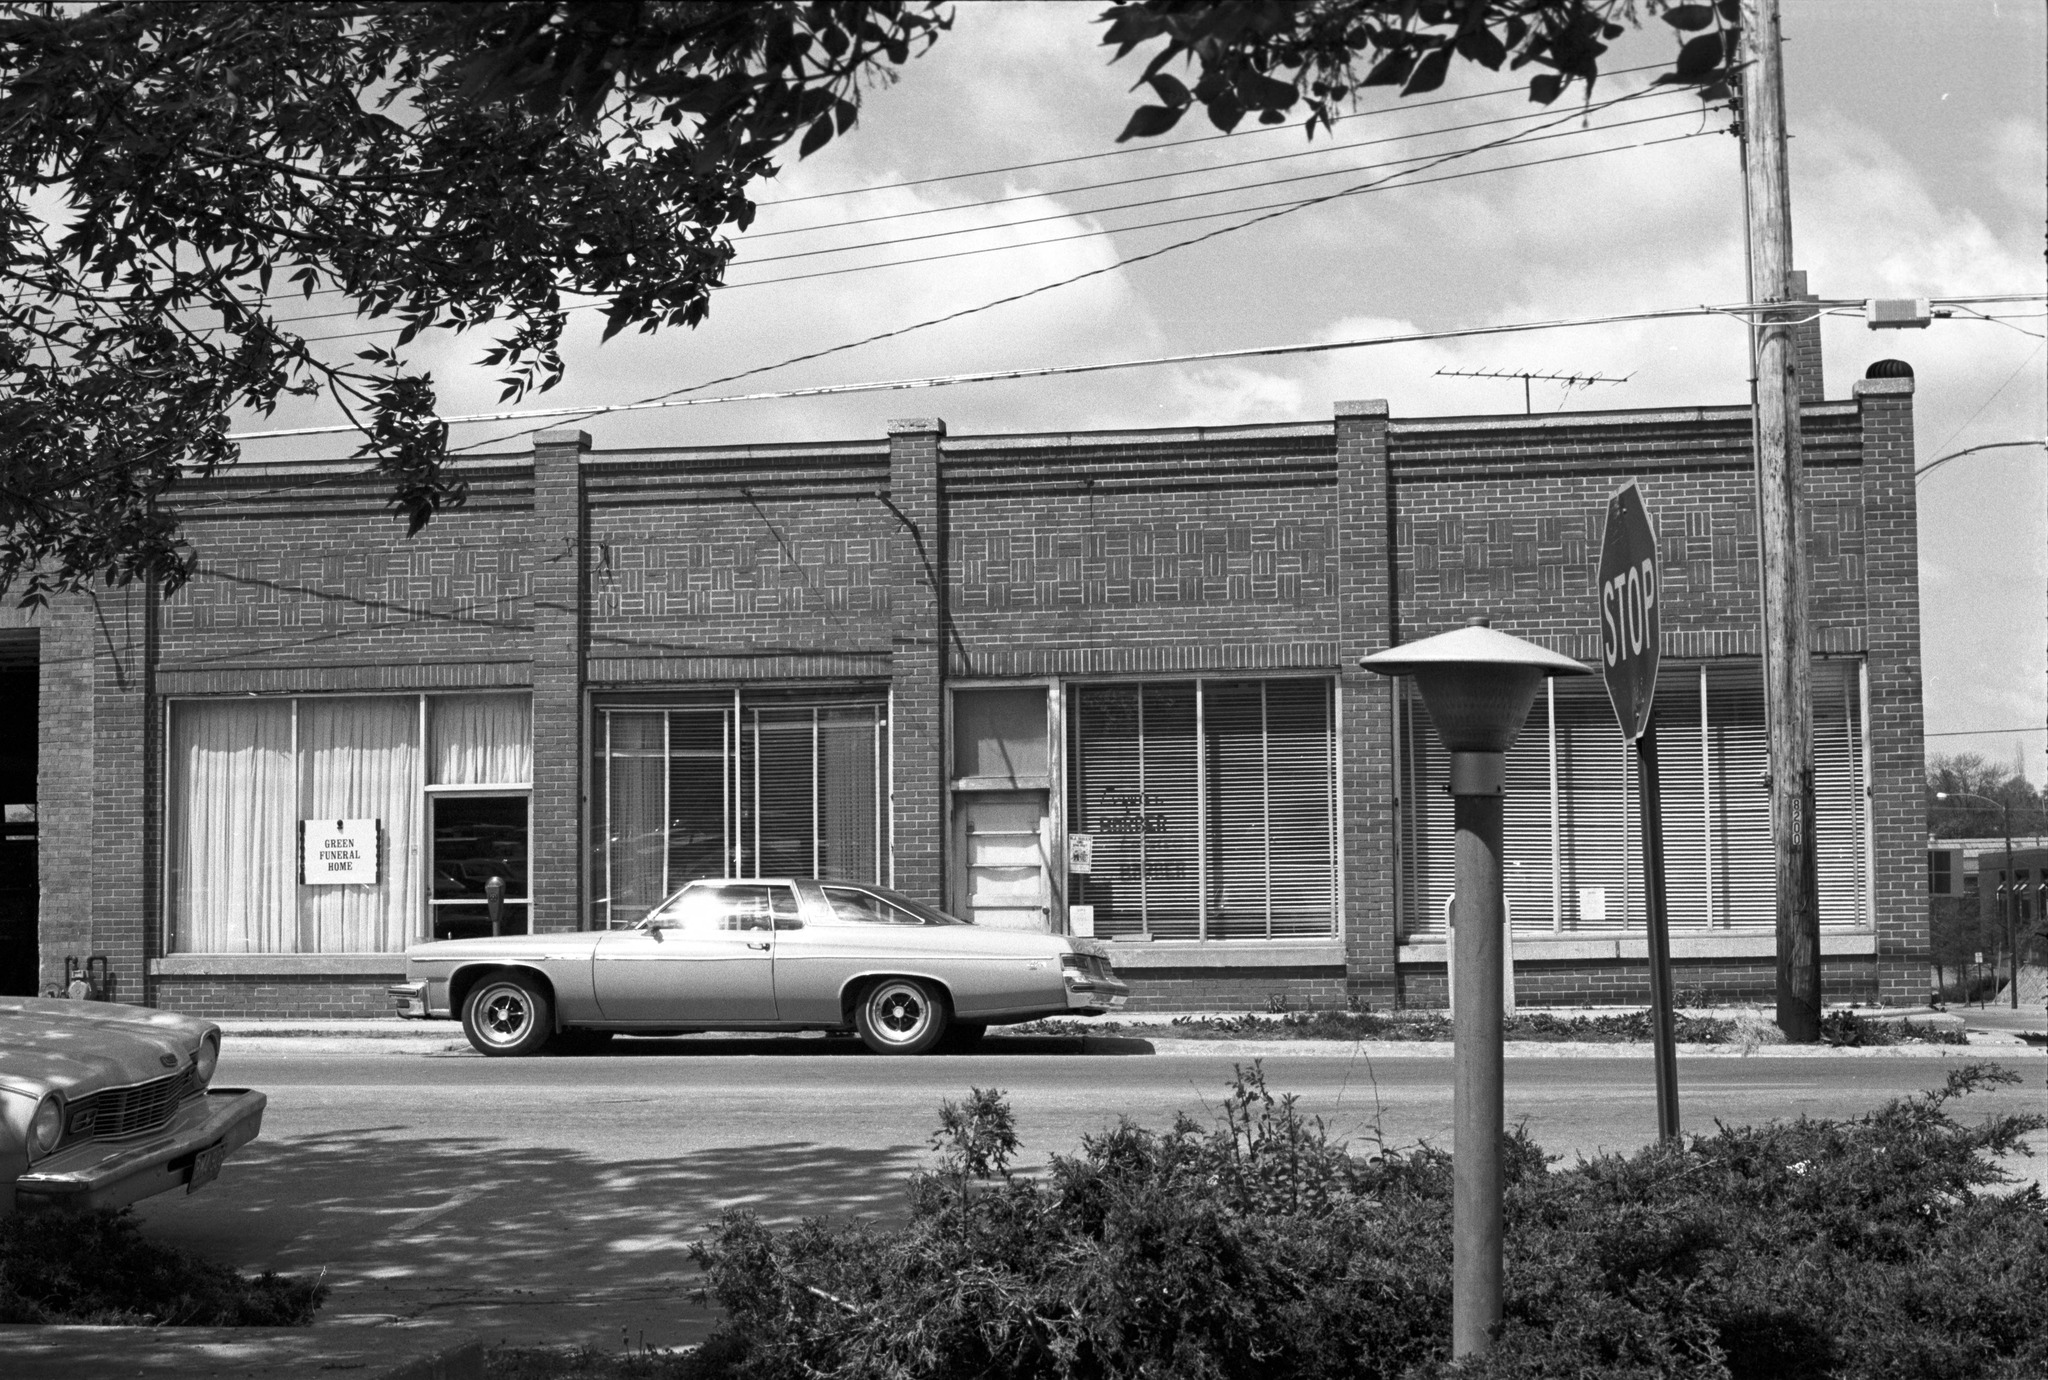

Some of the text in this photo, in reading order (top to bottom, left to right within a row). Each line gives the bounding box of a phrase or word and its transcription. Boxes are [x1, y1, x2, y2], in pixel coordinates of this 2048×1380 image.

[1603, 557, 1654, 667] STOP
[1100, 814, 1167, 834] BARBER
[1792, 799, 1801, 845] 8200
[324, 838, 354, 848] GREEN
[319, 850, 361, 860] FUNERAL
[328, 861, 353, 871] HOME
